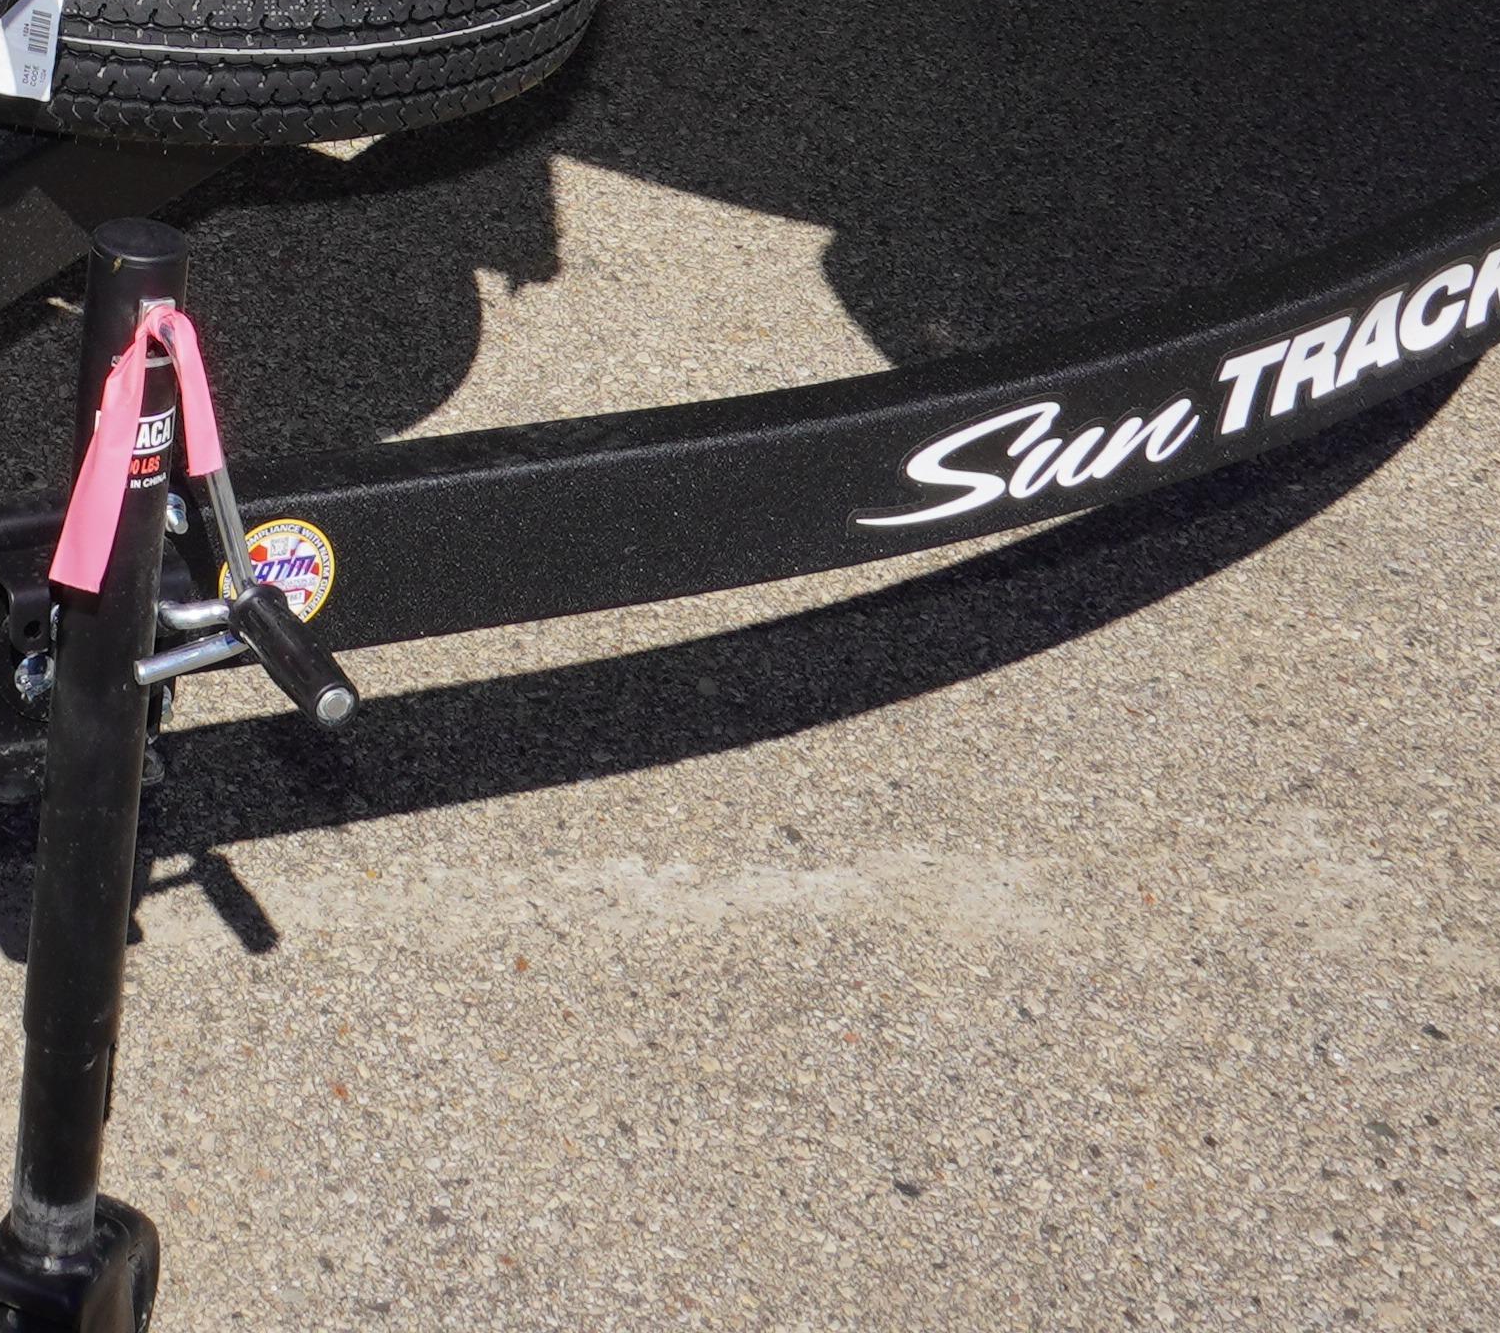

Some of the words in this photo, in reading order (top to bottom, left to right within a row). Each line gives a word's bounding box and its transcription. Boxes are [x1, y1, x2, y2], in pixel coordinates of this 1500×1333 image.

[22, 64, 31, 84] DATE
[30, 65, 40, 87] CODE
[856, 398, 1200, 528] Sun
[142, 472, 167, 488] CHINA
[246, 523, 300, 547] MPLIANCE
[301, 526, 323, 548] WITH
